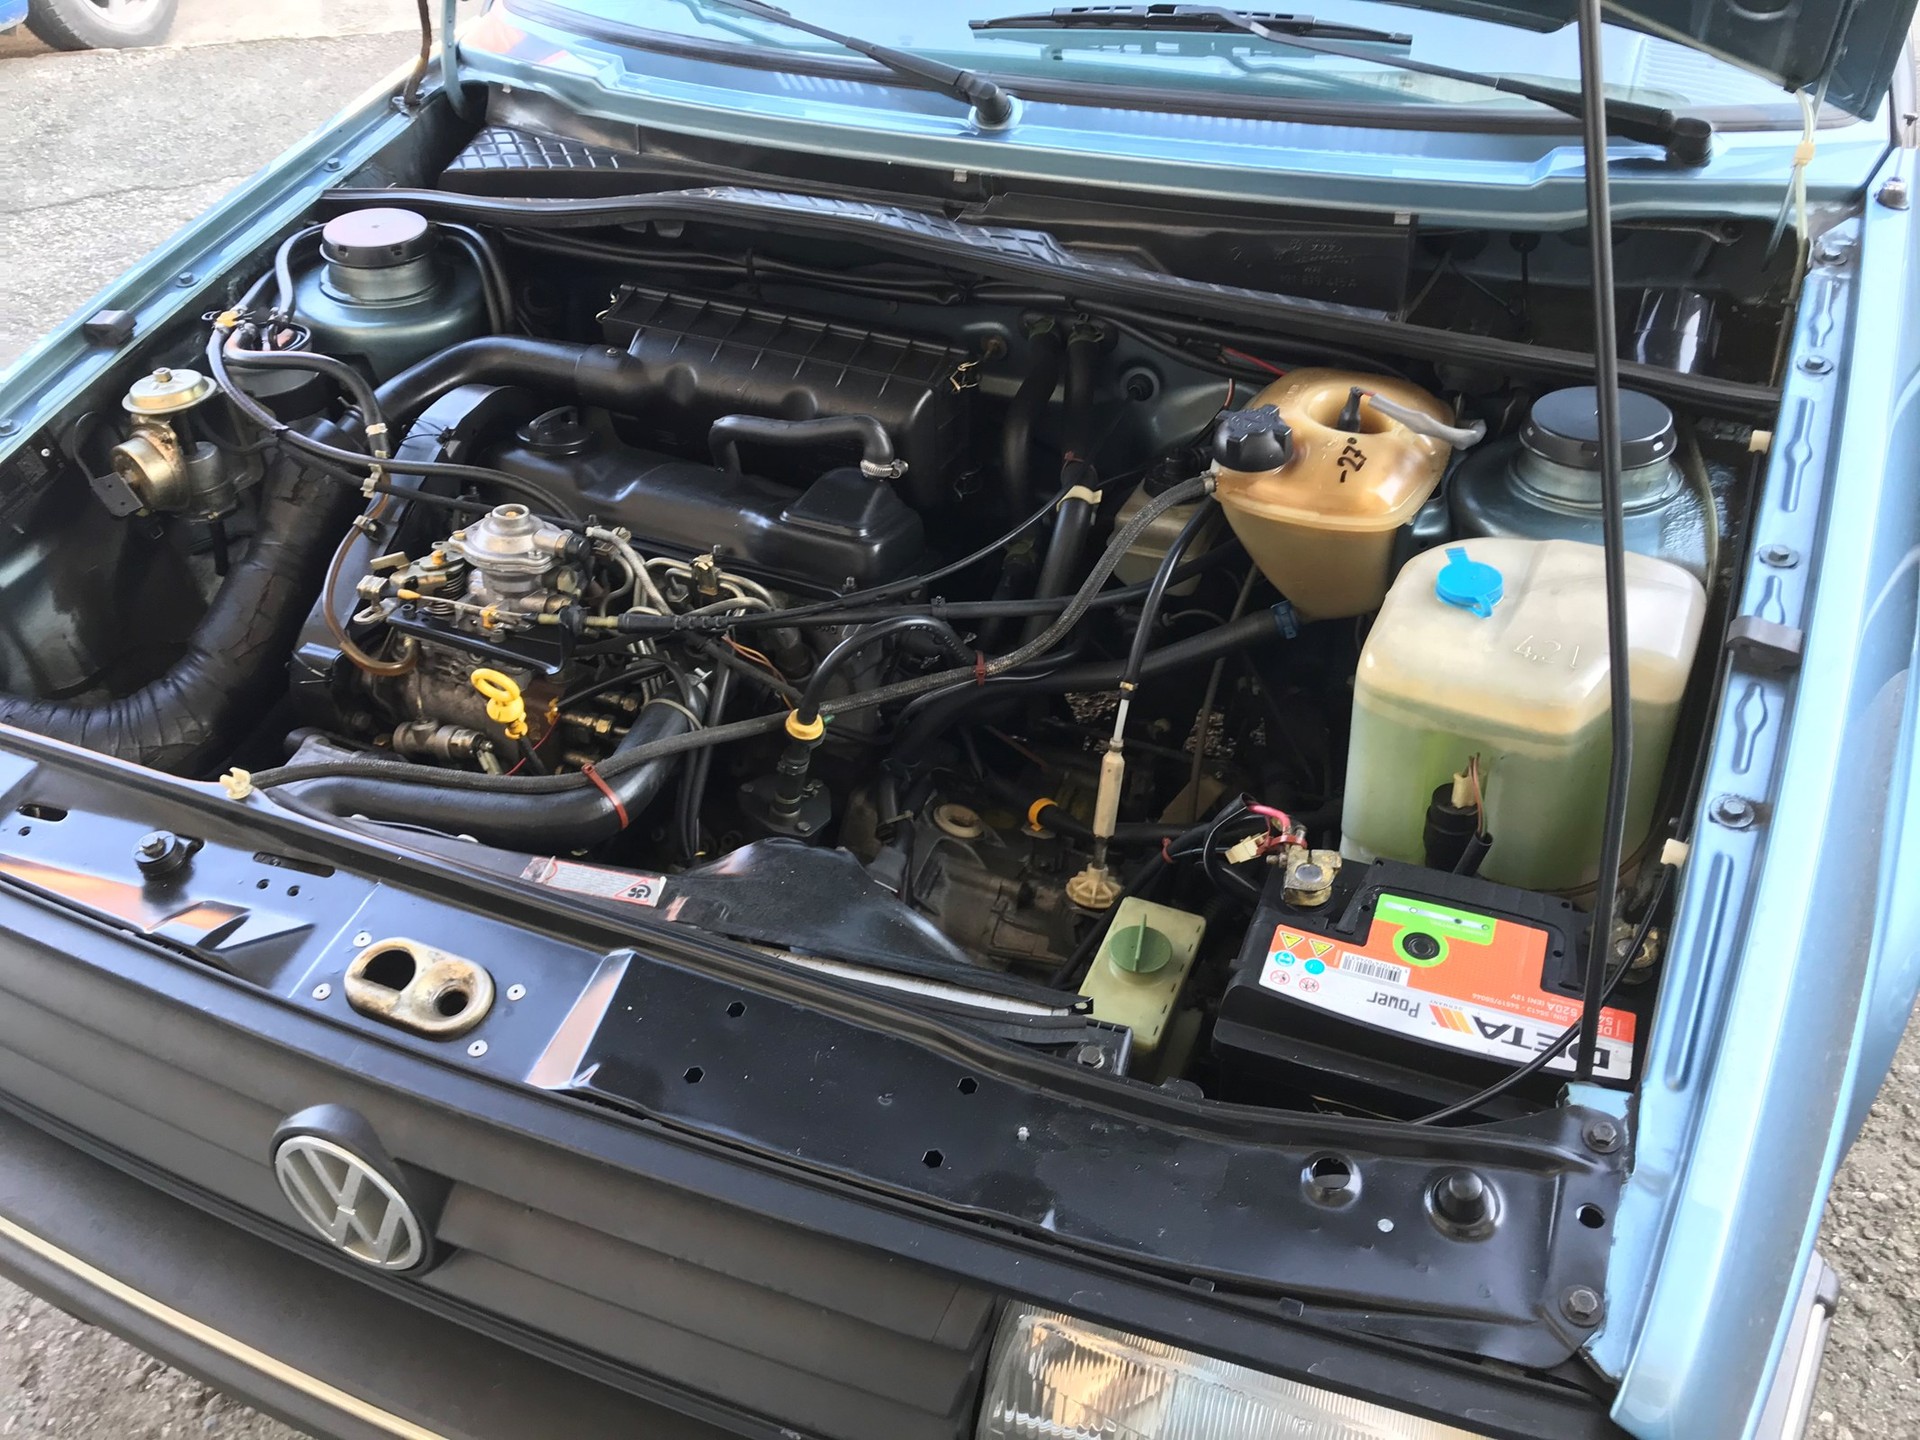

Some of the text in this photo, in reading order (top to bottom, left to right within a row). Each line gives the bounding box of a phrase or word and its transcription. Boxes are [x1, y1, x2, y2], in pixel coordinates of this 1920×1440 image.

[1366, 990, 1421, 1018] Power
[1547, 1002, 1578, 1017] 520A
[1472, 1014, 1610, 1069] DETA
